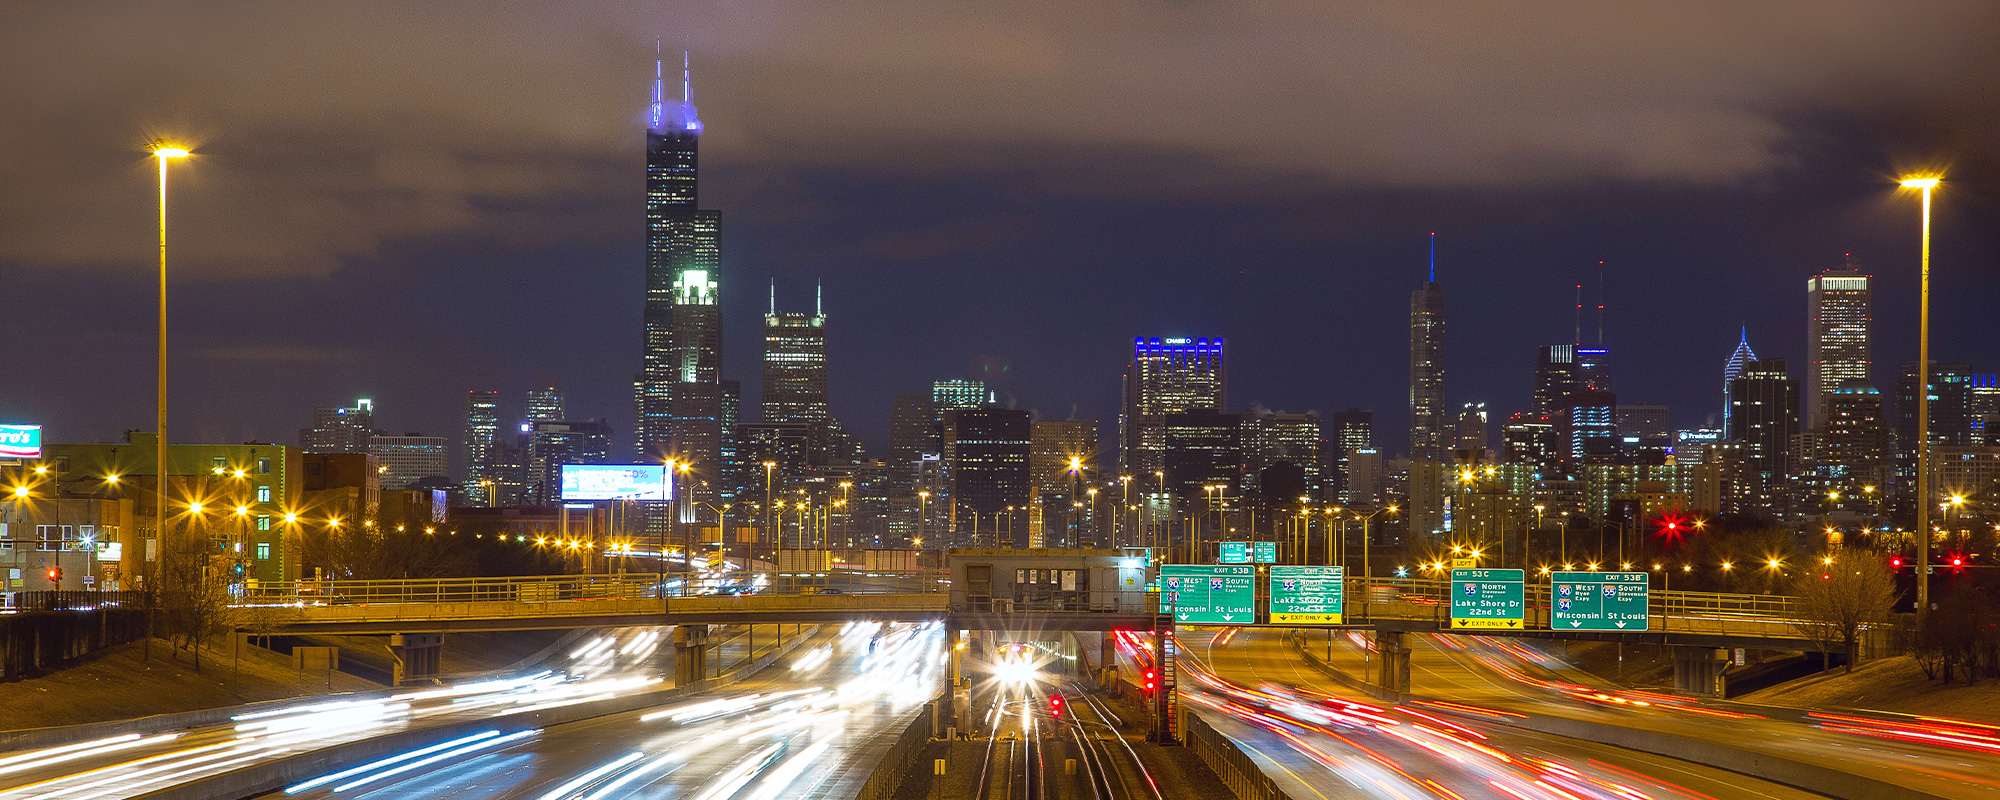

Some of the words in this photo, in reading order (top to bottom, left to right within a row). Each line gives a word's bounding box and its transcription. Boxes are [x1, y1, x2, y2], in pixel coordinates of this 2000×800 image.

[0, 430, 31, 443] ro's
[1168, 580, 1179, 588] 90
[1211, 580, 1222, 589] 55
[1283, 581, 1294, 590] 55
[1465, 586, 1476, 594] 55
[1559, 587, 1570, 595] 90
[1604, 588, 1615, 596] 55
[1480, 599, 1506, 607] Shore
[1559, 600, 1570, 609] 94
[1215, 605, 1225, 613] St
[1469, 608, 1492, 616] 22nd
[1496, 608, 1506, 616] St
[1556, 611, 1600, 619] Wisconsin
[1607, 612, 1617, 620] St
[1621, 612, 1646, 620] Louis
